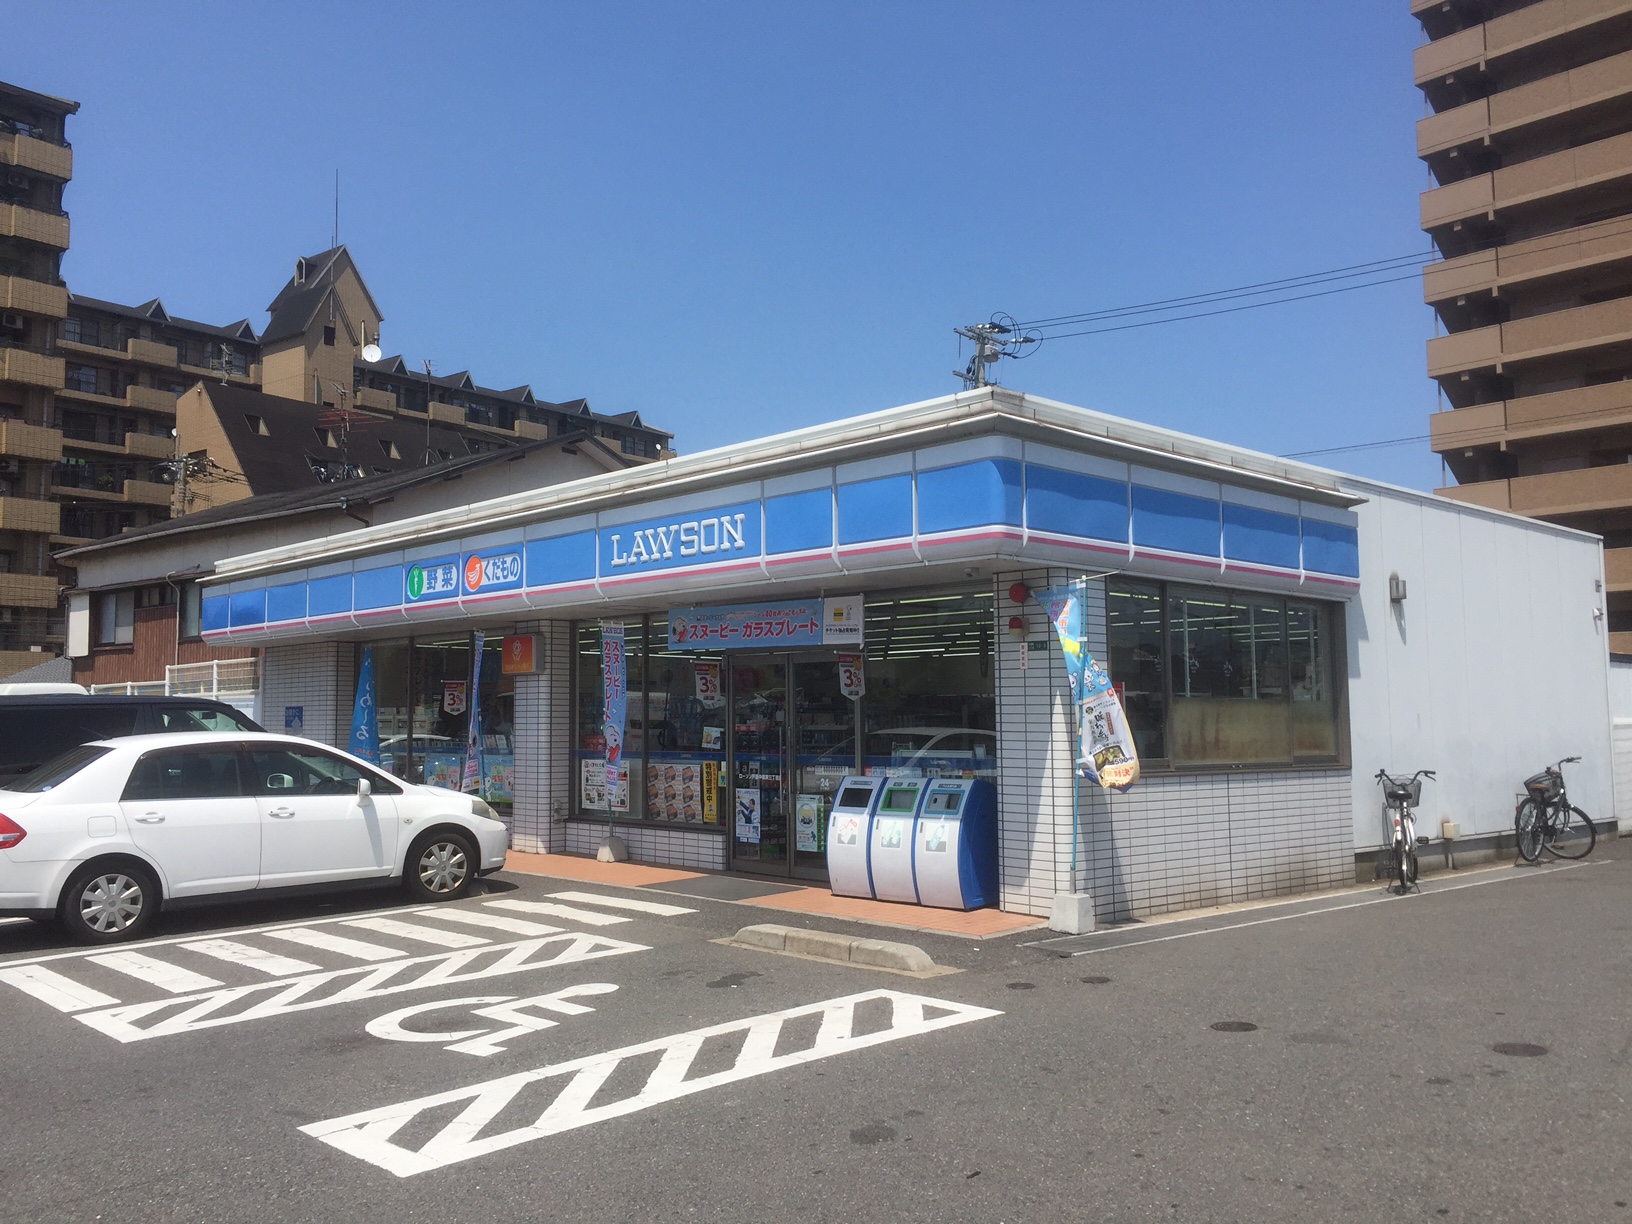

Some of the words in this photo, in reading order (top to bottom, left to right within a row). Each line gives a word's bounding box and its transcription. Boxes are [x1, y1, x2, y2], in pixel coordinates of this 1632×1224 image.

[611, 513, 746, 568] LAWSON
[426, 569, 454, 591] 野菜
[484, 557, 519, 582] くだもの
[689, 623, 739, 640] スヌーピー
[742, 617, 819, 638] ガラスプレート
[604, 640, 612, 723] ガラスプレート
[612, 641, 621, 699] スヌーピー
[843, 669, 861, 687] 3%
[699, 676, 717, 693] 3%
[820, 778, 829, 787] 24
